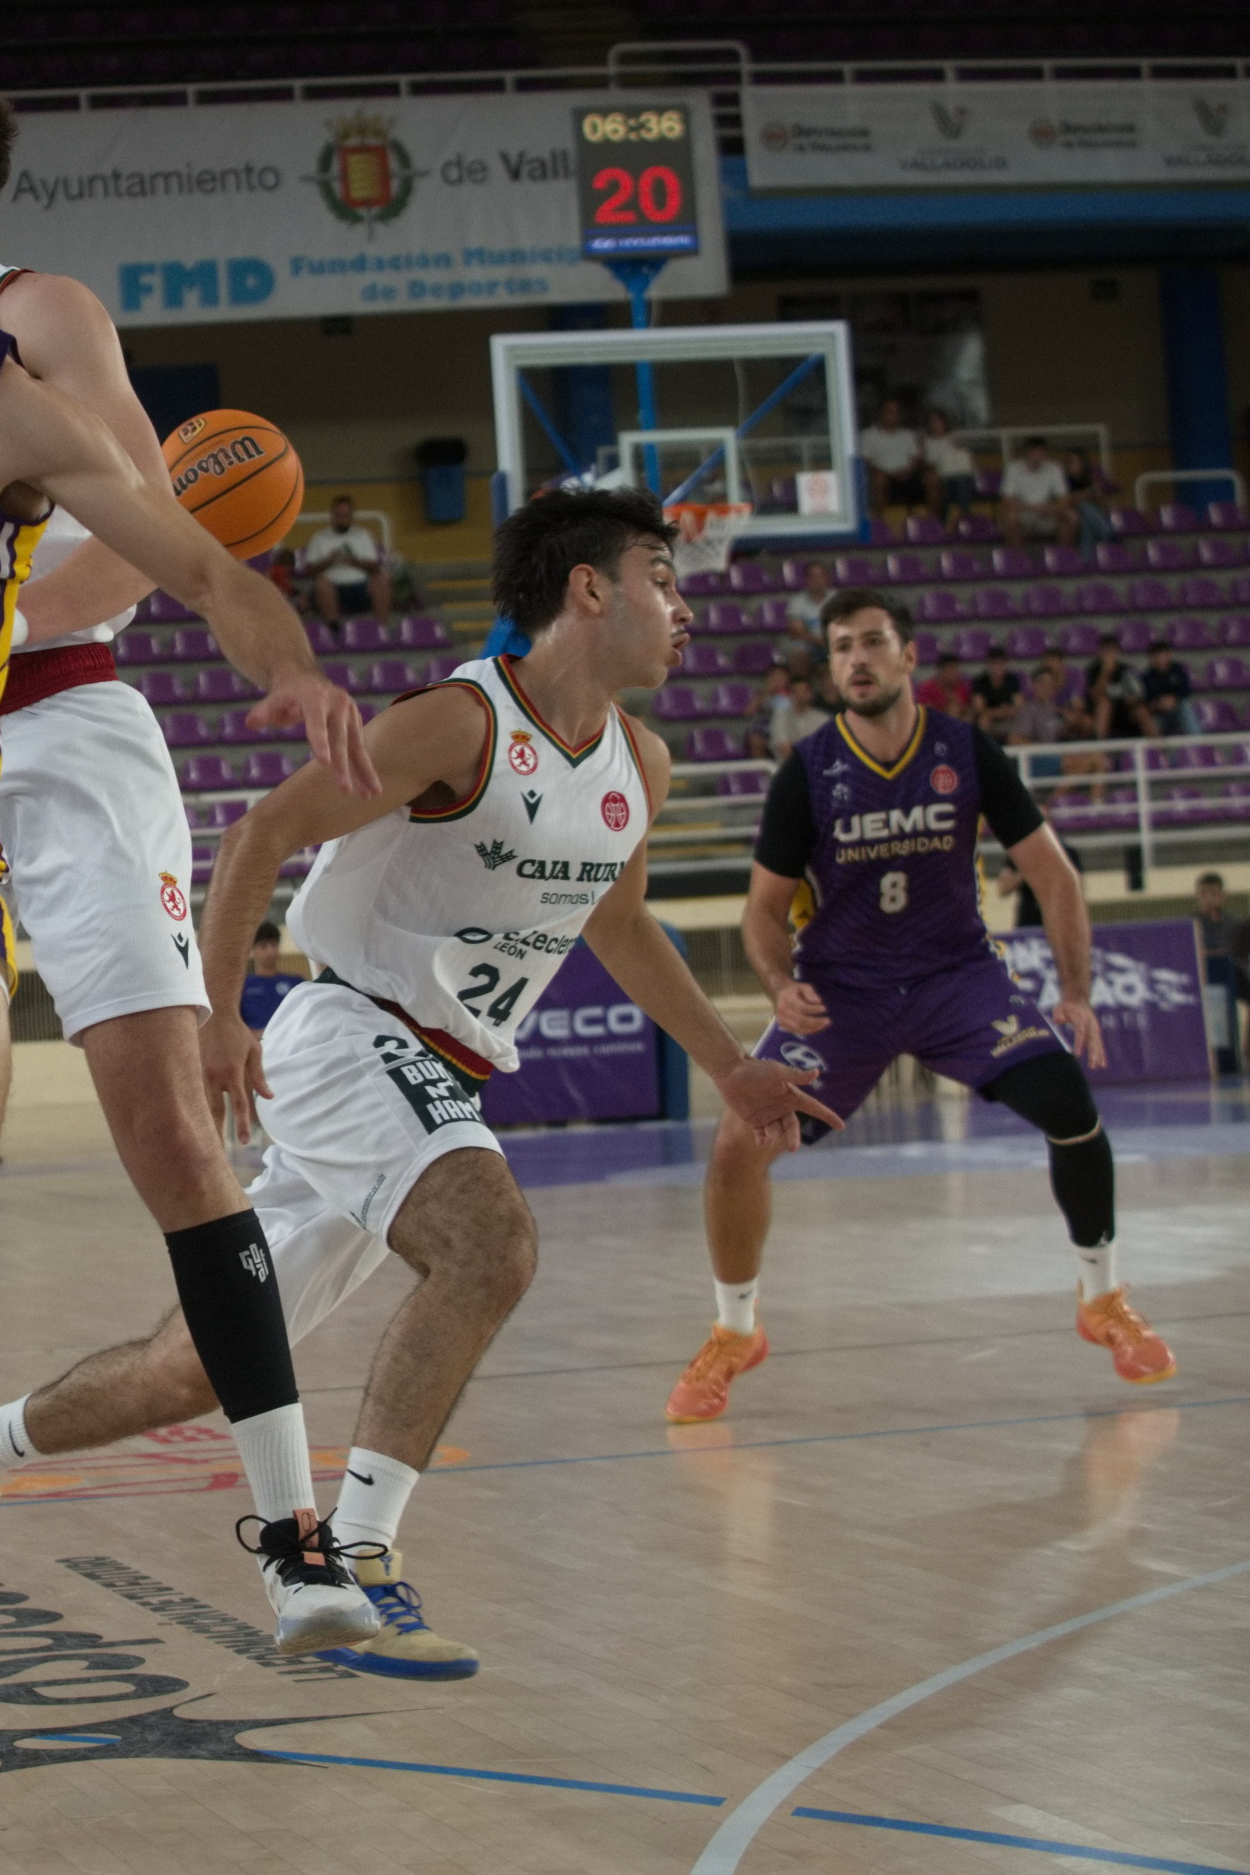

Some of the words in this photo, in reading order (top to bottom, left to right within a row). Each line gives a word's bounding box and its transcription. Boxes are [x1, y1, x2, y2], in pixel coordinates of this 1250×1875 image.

[582, 110, 684, 143] 06:36
[13, 160, 281, 209] Ayuntamiento
[440, 152, 488, 186] de
[591, 166, 684, 225] 20
[119, 257, 275, 312] FMD
[290, 251, 449, 274] Fundación
[361, 281, 391, 301] de
[400, 276, 549, 304] Deportes
[172, 435, 267, 497] Wilson
[833, 802, 957, 843] UEMC
[516, 858, 570, 881] CAJA
[835, 835, 955, 865] UNIVERSIDAD
[878, 871, 910, 914] 8
[493, 941, 528, 960] LEÓN
[457, 963, 530, 1027] 24
[516, 1003, 644, 1041] VECO
[426, 1099, 481, 1125] HAM
